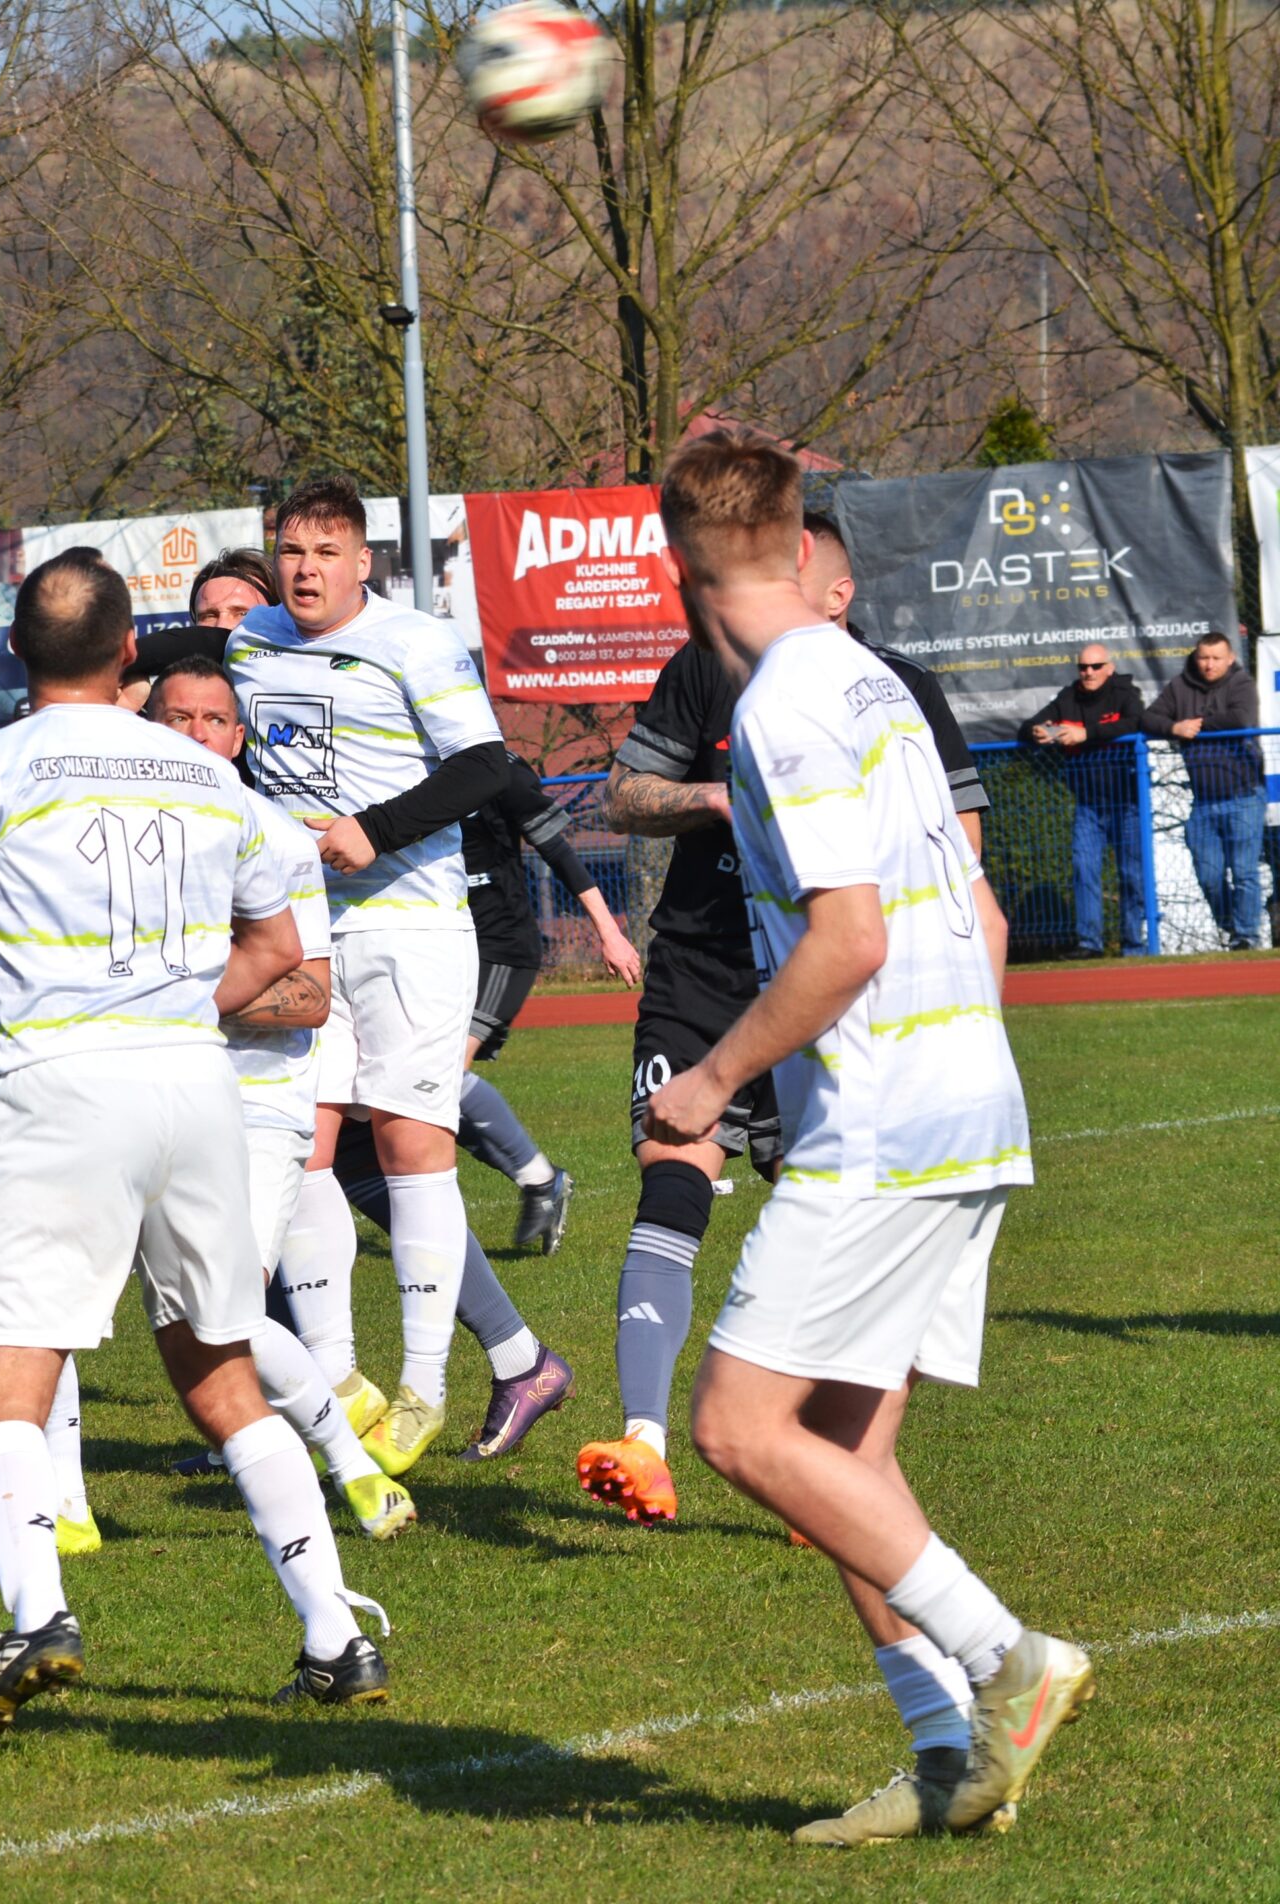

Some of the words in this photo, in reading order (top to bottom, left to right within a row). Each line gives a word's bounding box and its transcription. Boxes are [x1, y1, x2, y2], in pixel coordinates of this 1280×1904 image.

[575, 562, 638, 578] KUCHNIE
[930, 546, 1134, 593] DASTEK
[126, 571, 197, 591] RENO-
[564, 577, 650, 594] GARDEROBY
[555, 596, 607, 610] REGAŁY
[616, 593, 662, 608] SZAFY
[961, 585, 1111, 607] SOLUTIONS
[530, 631, 586, 647] CZADRÓW
[598, 629, 655, 644] KAMIENNA
[657, 627, 690, 641] GÓRA
[965, 632, 1031, 649] SYSTEMY
[1032, 624, 1129, 645] LAKIERNICZE
[558, 650, 577, 662] 600
[578, 649, 597, 661] 268
[29, 757, 62, 781] GKS
[60, 756, 108, 779] WARTA
[106, 758, 221, 789] BOLESŁAWIECKA
[76, 807, 191, 978] 11
[632, 1053, 672, 1102] 10
